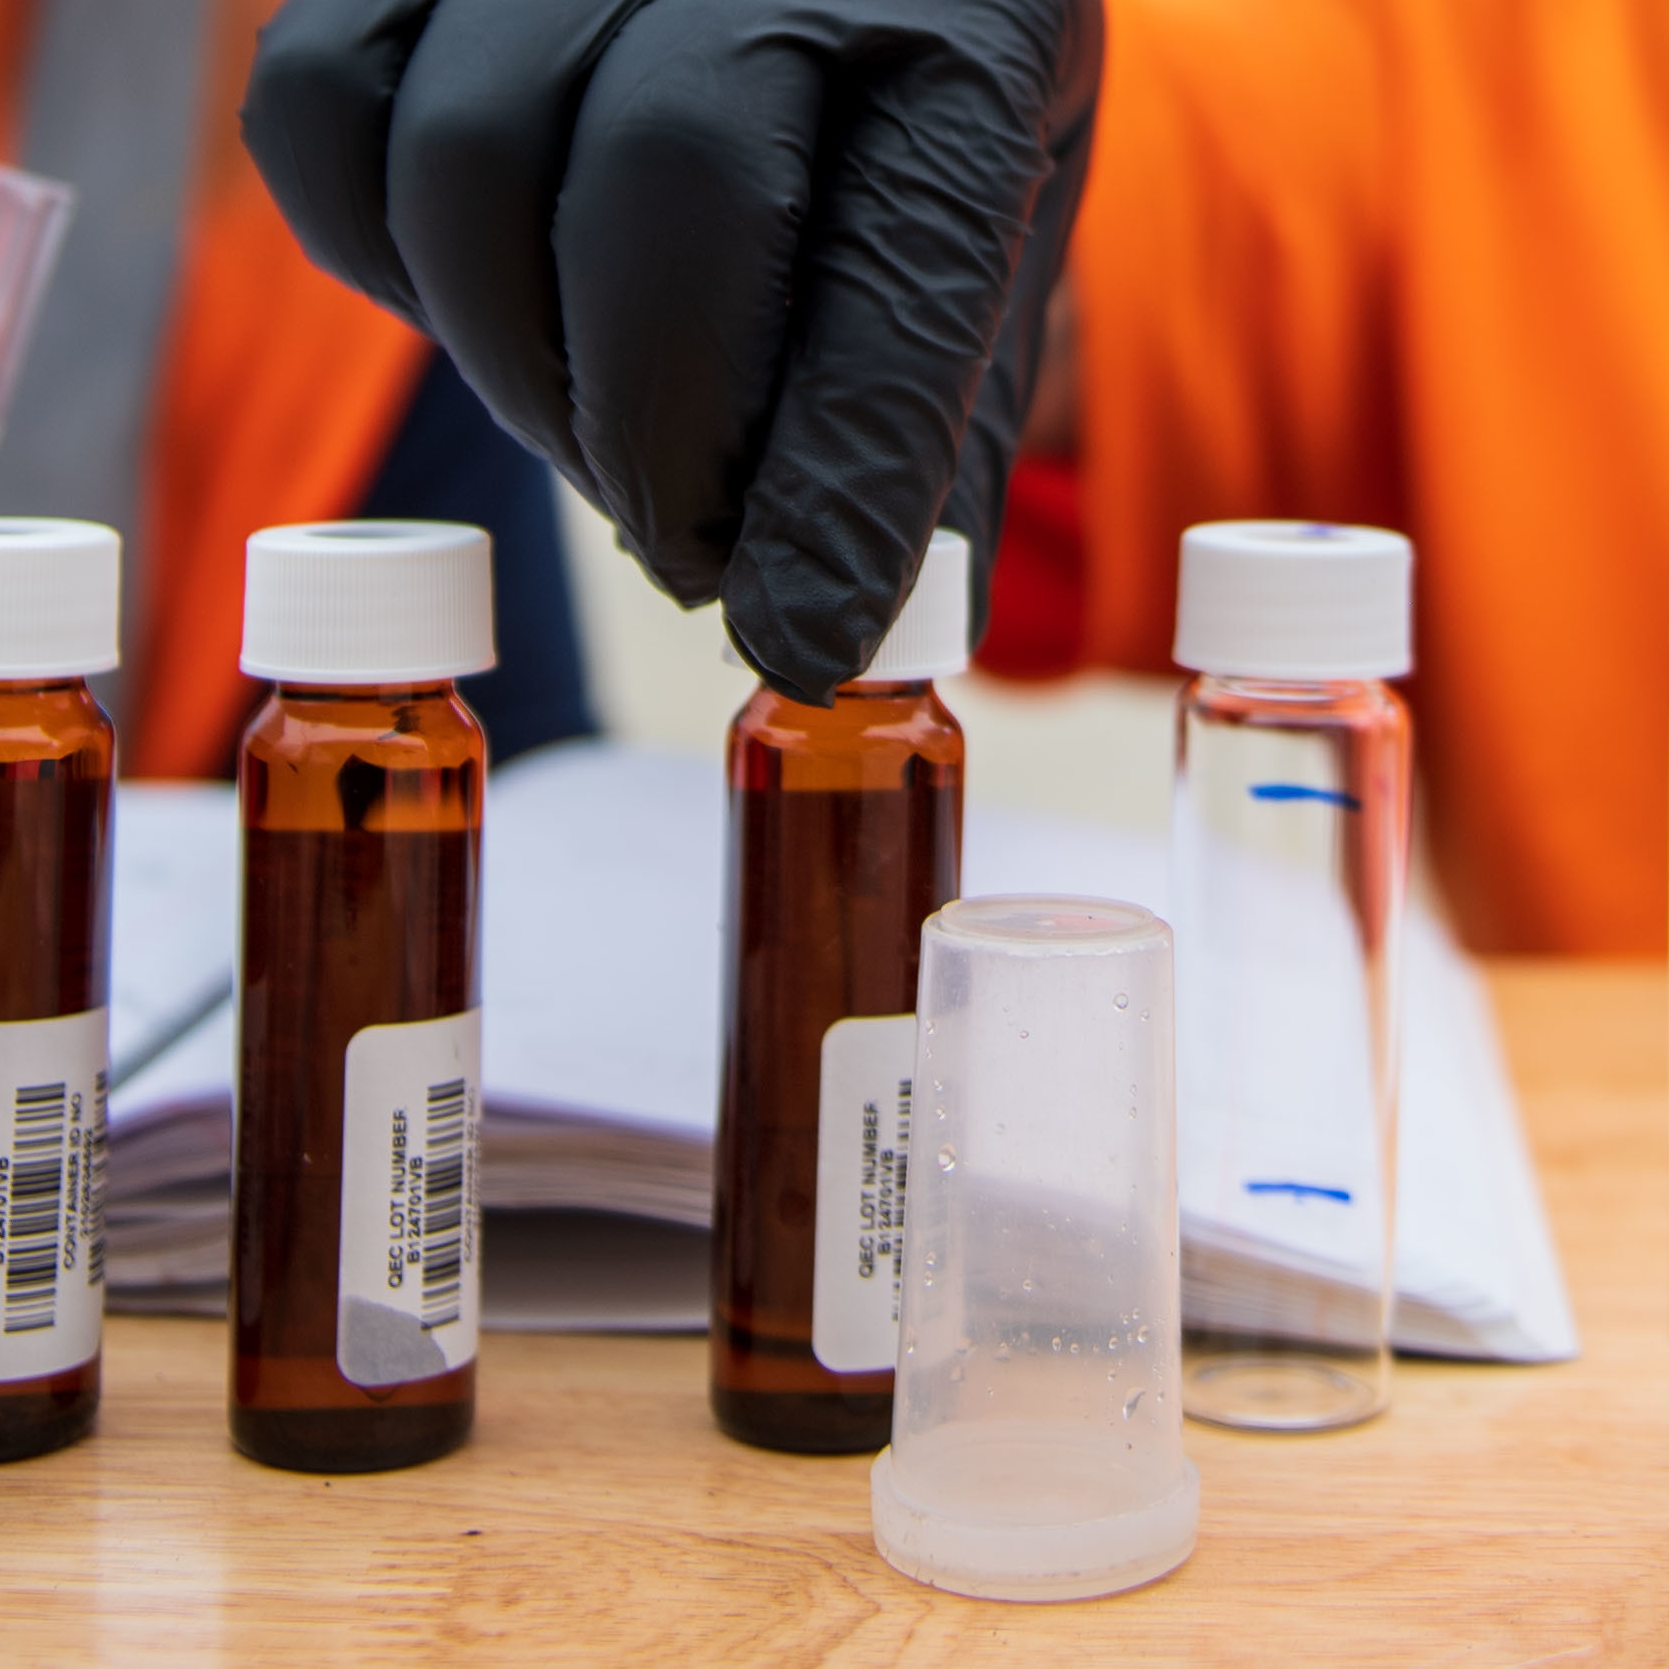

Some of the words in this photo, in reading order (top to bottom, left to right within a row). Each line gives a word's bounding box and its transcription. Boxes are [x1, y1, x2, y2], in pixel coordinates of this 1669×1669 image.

[389, 1198, 405, 1239] LOT
[406, 1154, 423, 1265] B124701VB
[860, 1191, 876, 1230] LOT
[387, 1244, 404, 1289] QEC
[858, 1234, 875, 1279] QEC
